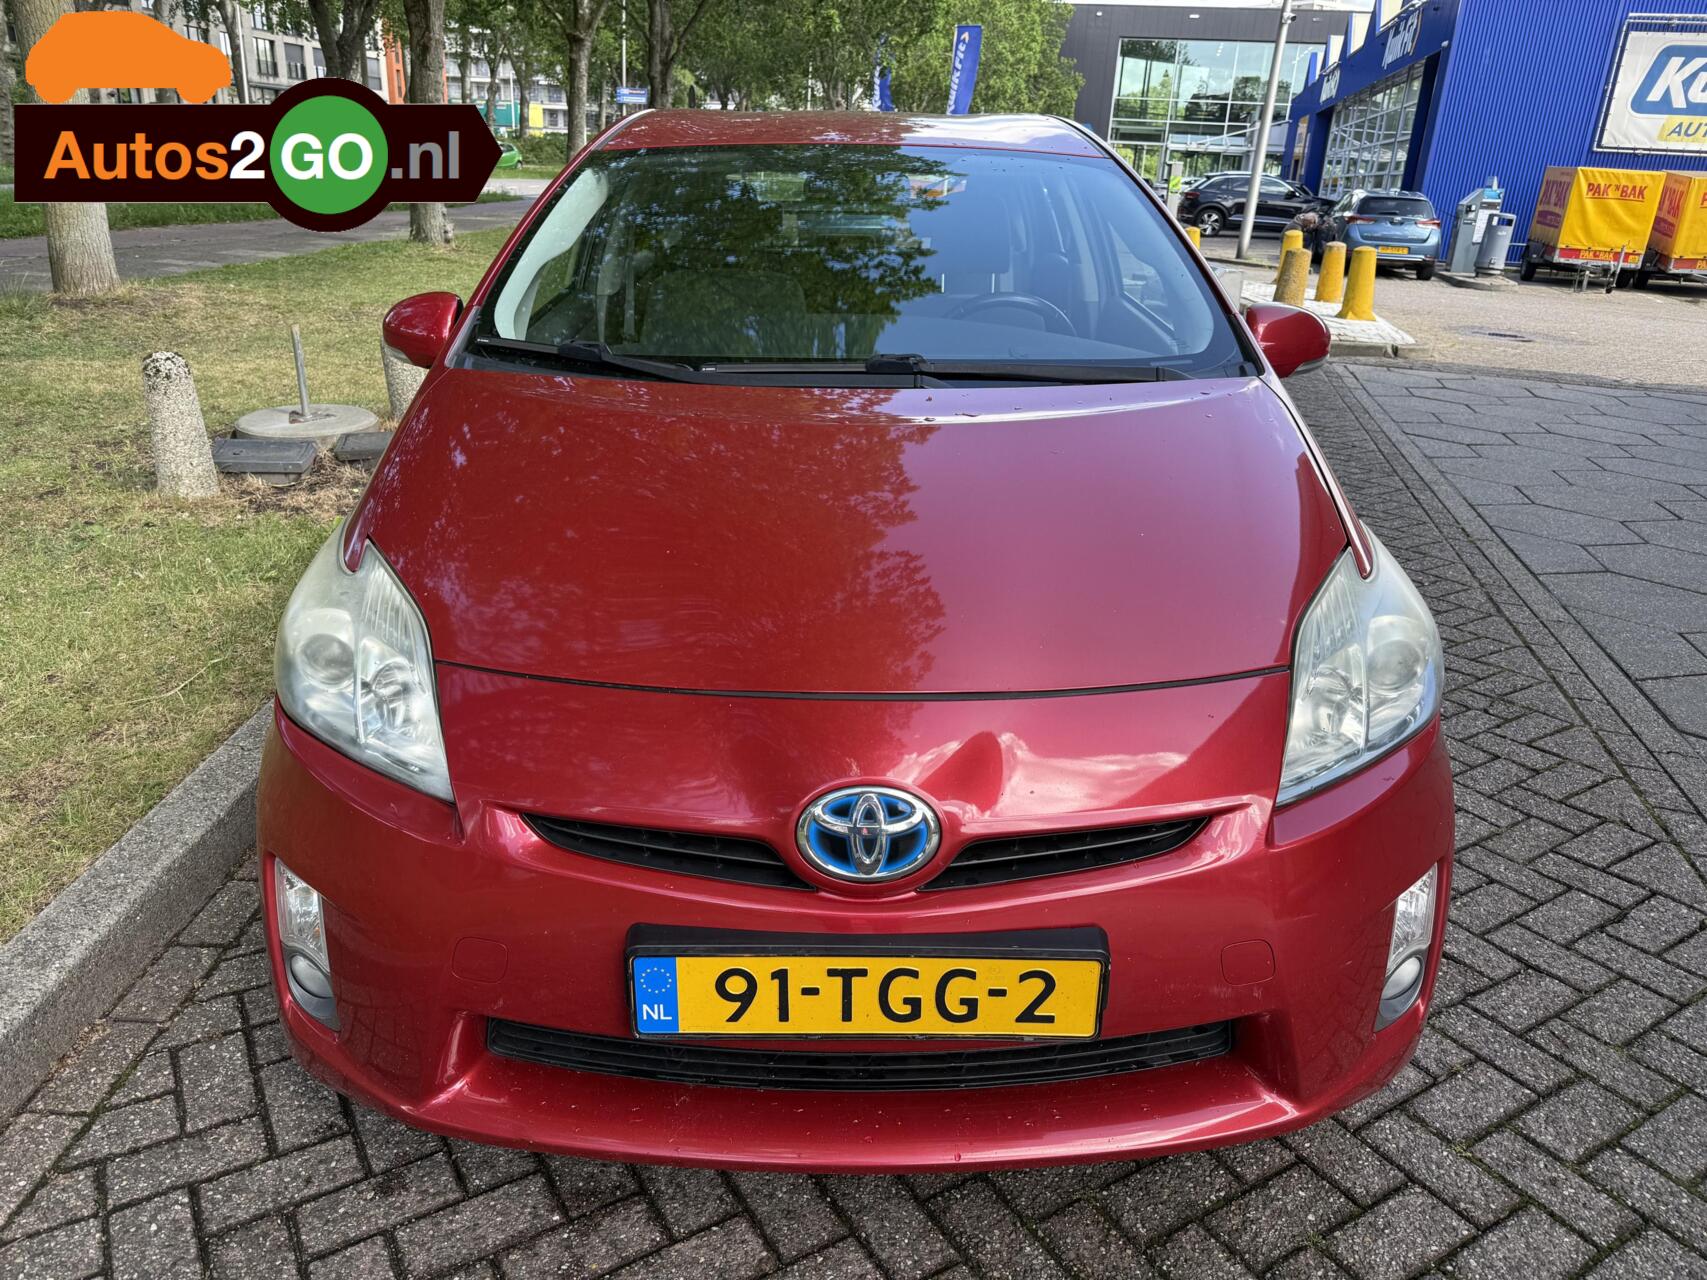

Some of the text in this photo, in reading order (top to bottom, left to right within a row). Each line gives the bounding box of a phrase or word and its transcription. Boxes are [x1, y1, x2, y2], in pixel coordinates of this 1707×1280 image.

[1586, 182, 1613, 197] PAK
[1620, 185, 1648, 200] BAK
[714, 966, 1058, 1024] 91-TGG-2
[642, 1004, 673, 1021] NL
